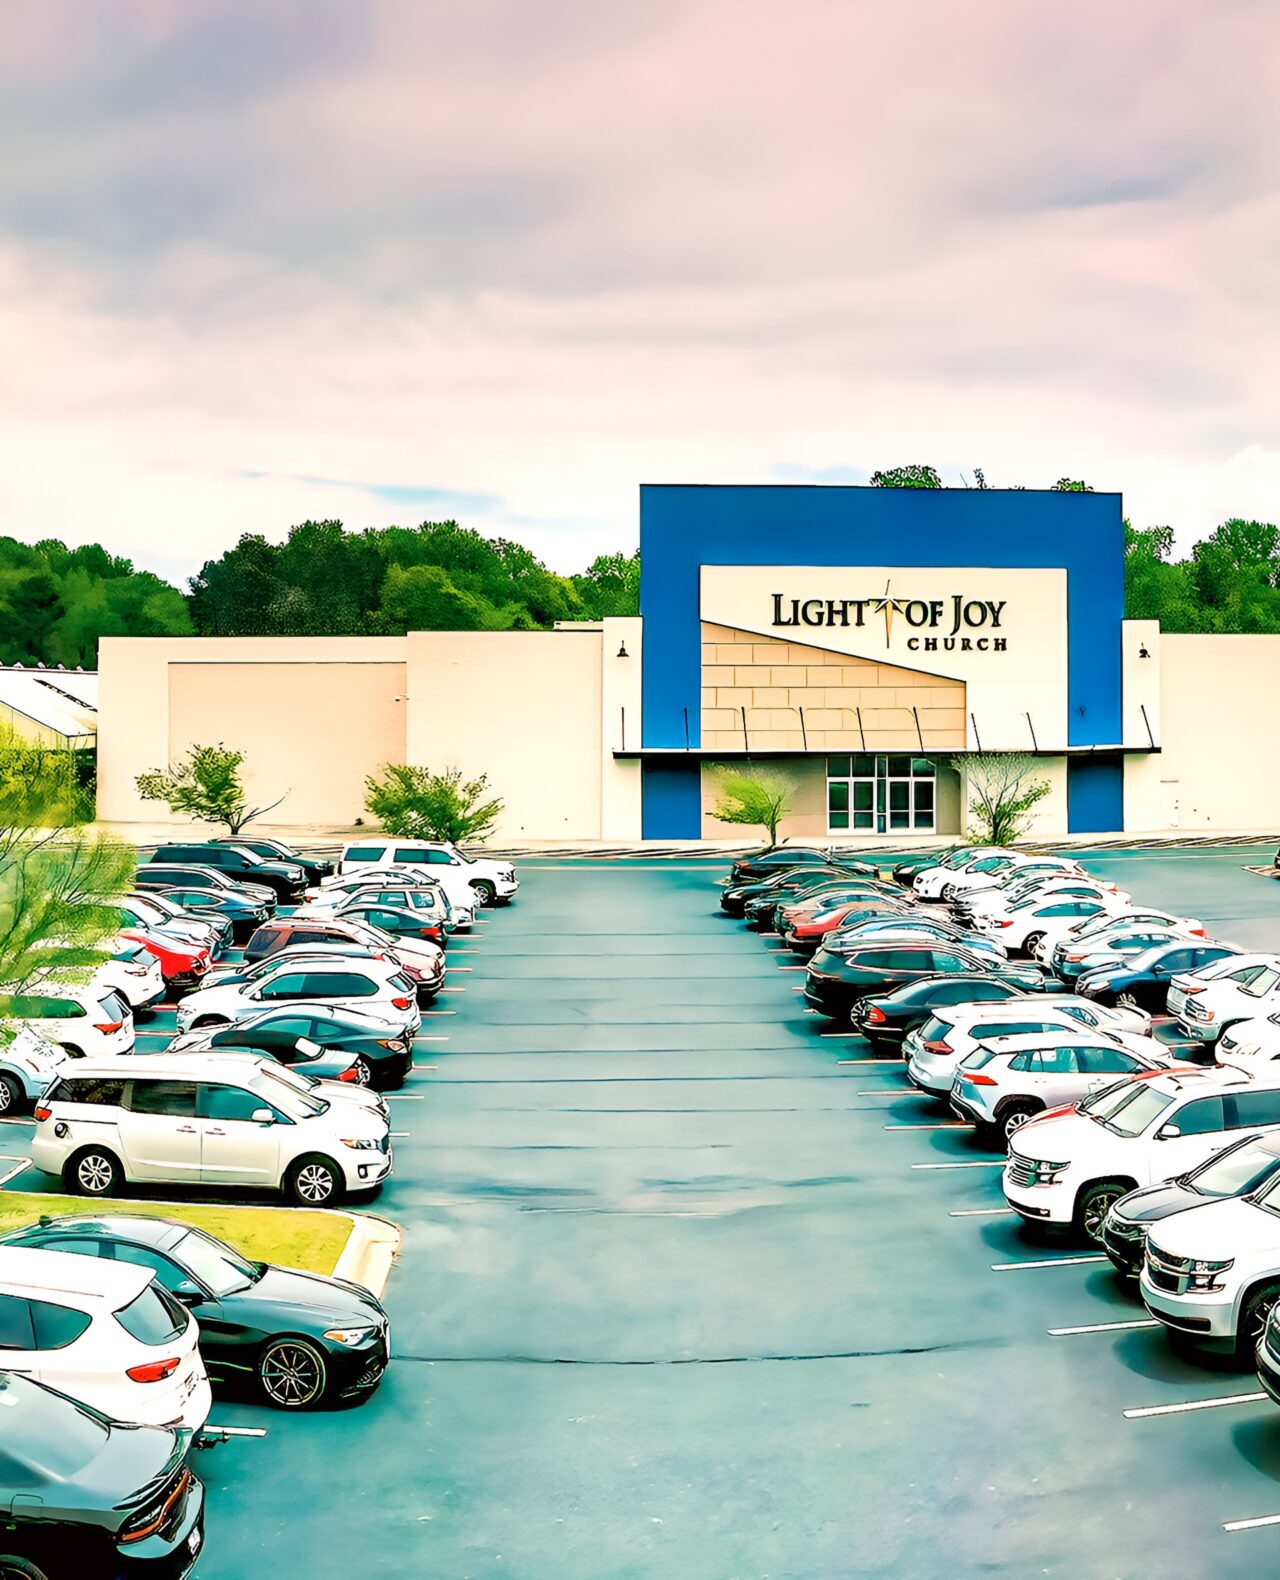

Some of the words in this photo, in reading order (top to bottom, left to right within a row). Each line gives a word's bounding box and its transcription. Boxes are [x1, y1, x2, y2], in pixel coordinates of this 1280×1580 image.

[771, 593, 870, 627] LIGHT
[904, 600, 944, 627] OF
[949, 595, 1007, 637] JOY
[907, 637, 1007, 652] CHURCH
